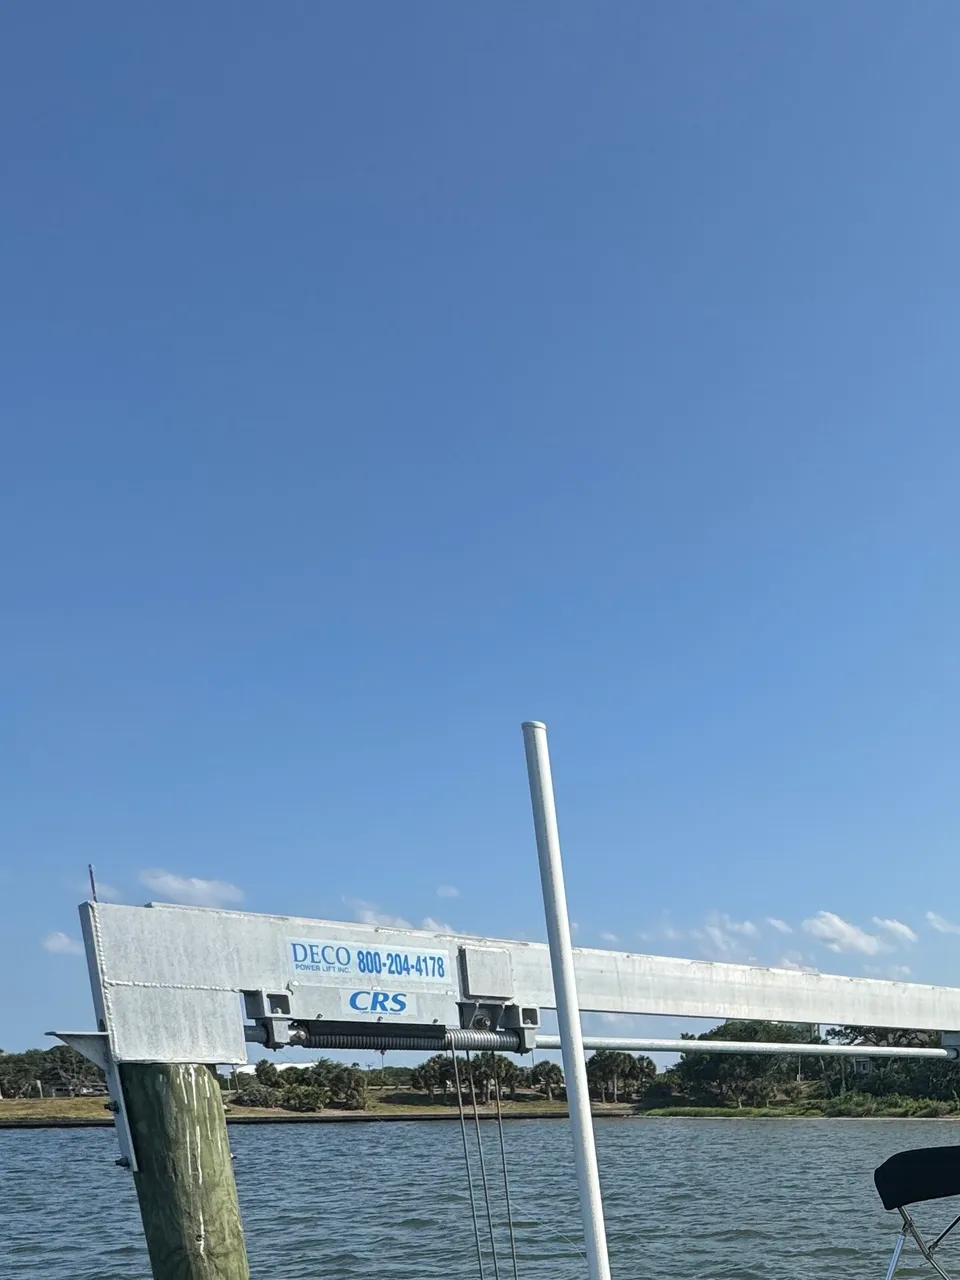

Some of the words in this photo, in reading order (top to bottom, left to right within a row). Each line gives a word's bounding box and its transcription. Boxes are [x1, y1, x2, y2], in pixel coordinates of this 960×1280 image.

[291, 943, 351, 965] DECO
[357, 950, 445, 978] 800-204-4178
[295, 963, 320, 971] POWER
[349, 991, 407, 1012] CRS
